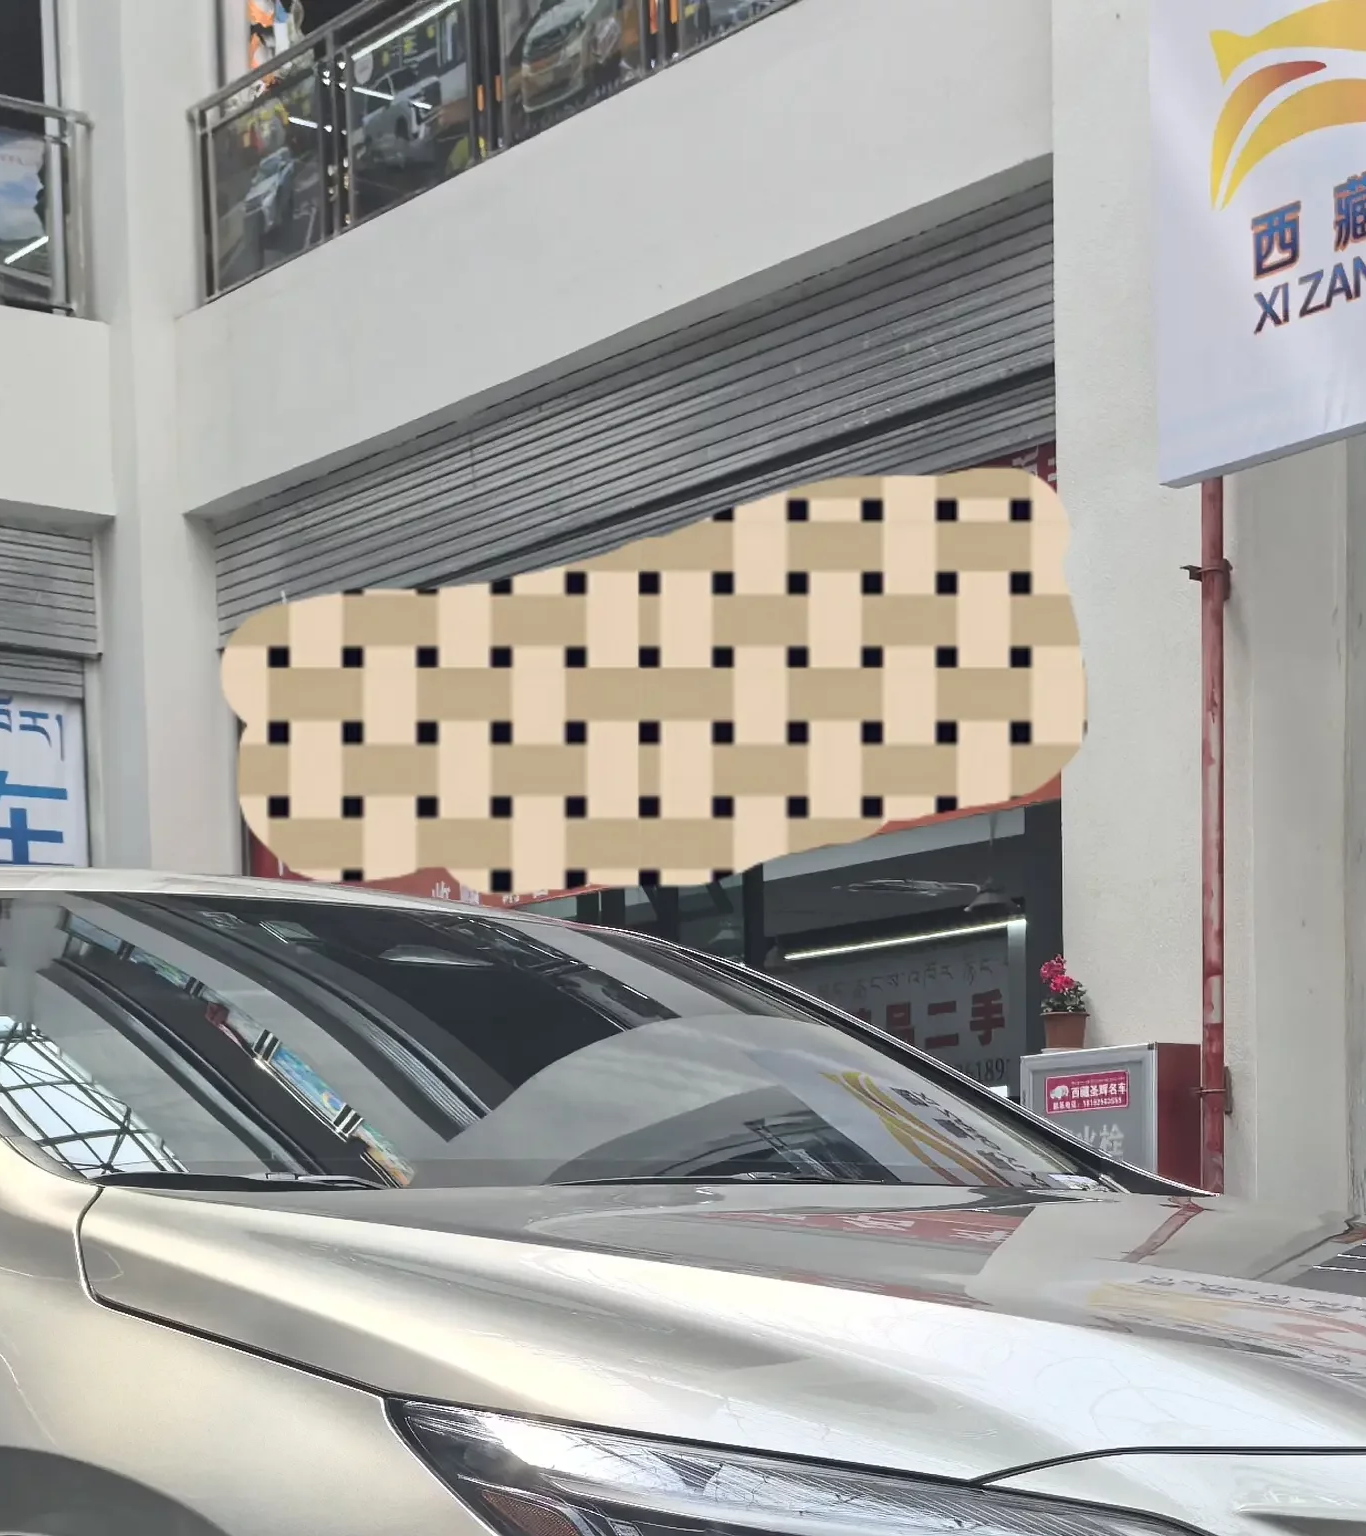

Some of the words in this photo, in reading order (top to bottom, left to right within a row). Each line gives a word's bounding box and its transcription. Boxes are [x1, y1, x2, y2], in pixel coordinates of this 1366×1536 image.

[1253, 281, 1291, 336] XI
[851, 988, 1006, 1048] 品二手
